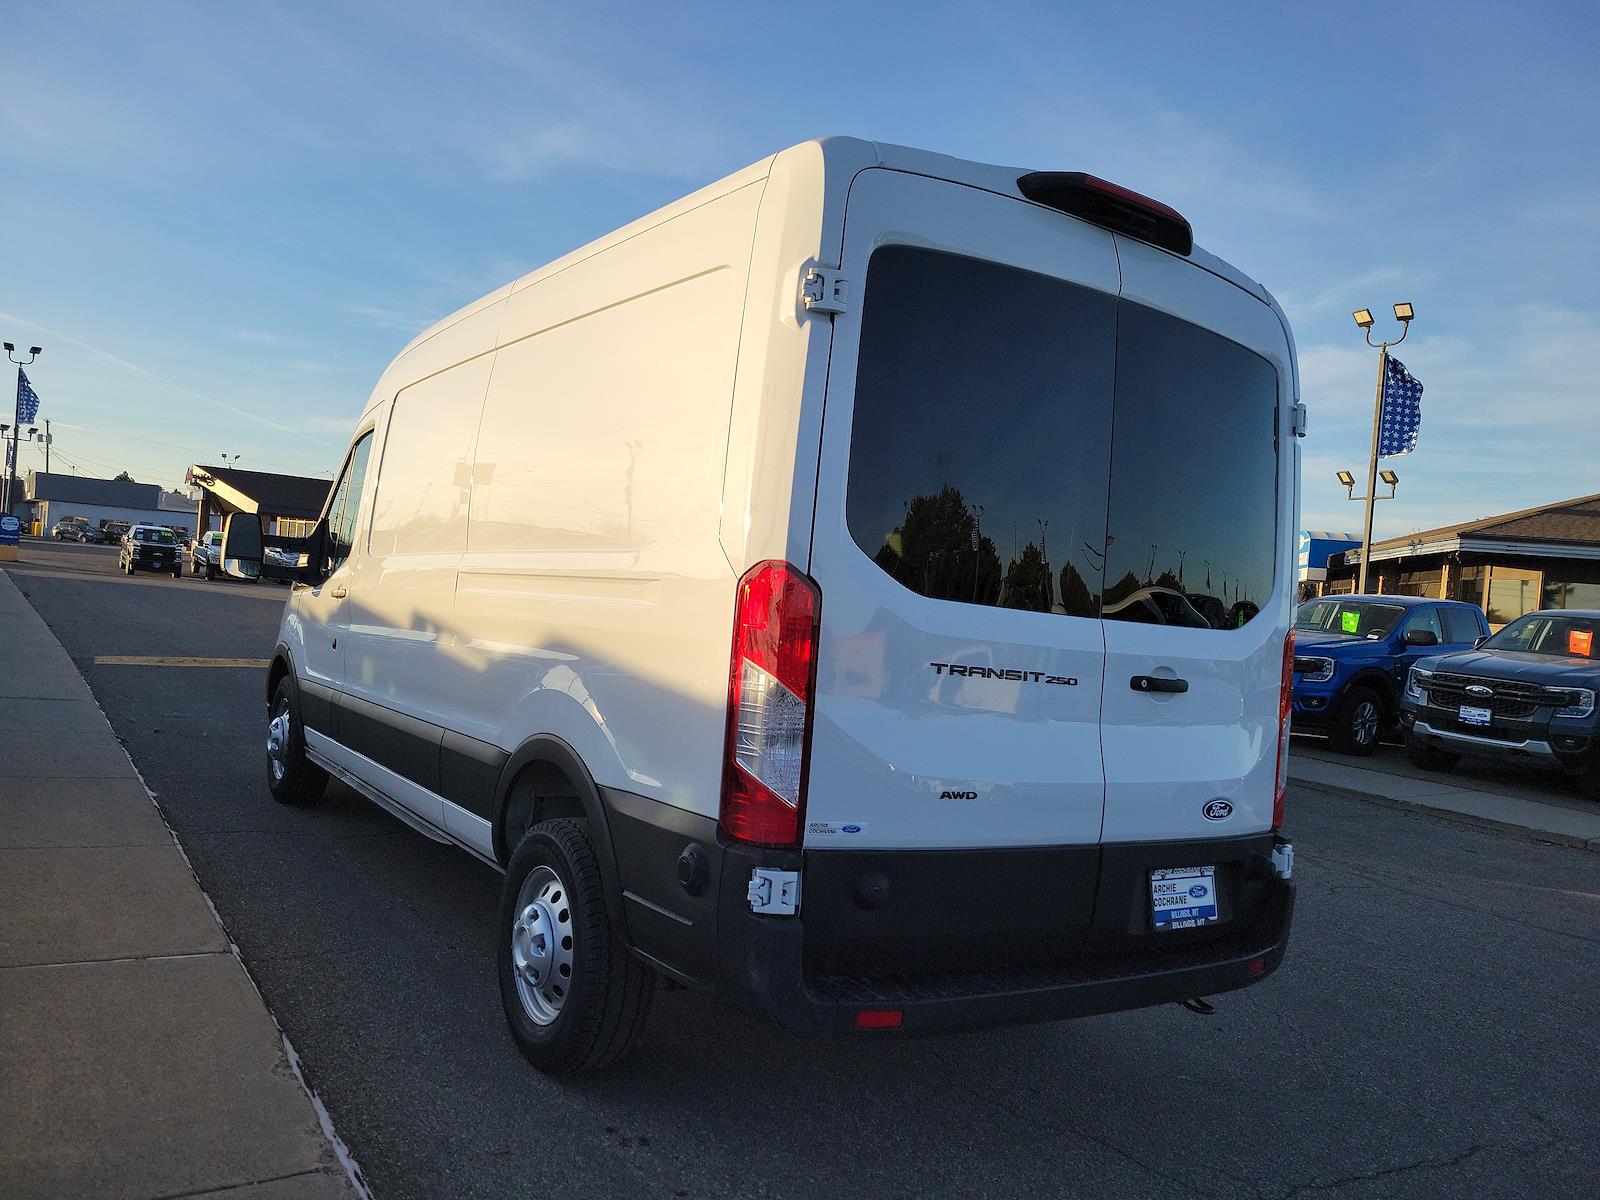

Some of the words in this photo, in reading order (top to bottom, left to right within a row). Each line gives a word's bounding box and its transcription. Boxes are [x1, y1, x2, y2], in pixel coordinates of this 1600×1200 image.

[930, 662, 1046, 684] TRANSIT
[1046, 675, 1078, 686] 250
[939, 790, 978, 801] AWD
[1153, 883, 1177, 894] ARCHIE
[1154, 895, 1187, 907] COCHRANE
[1196, 918, 1206, 927] MT
